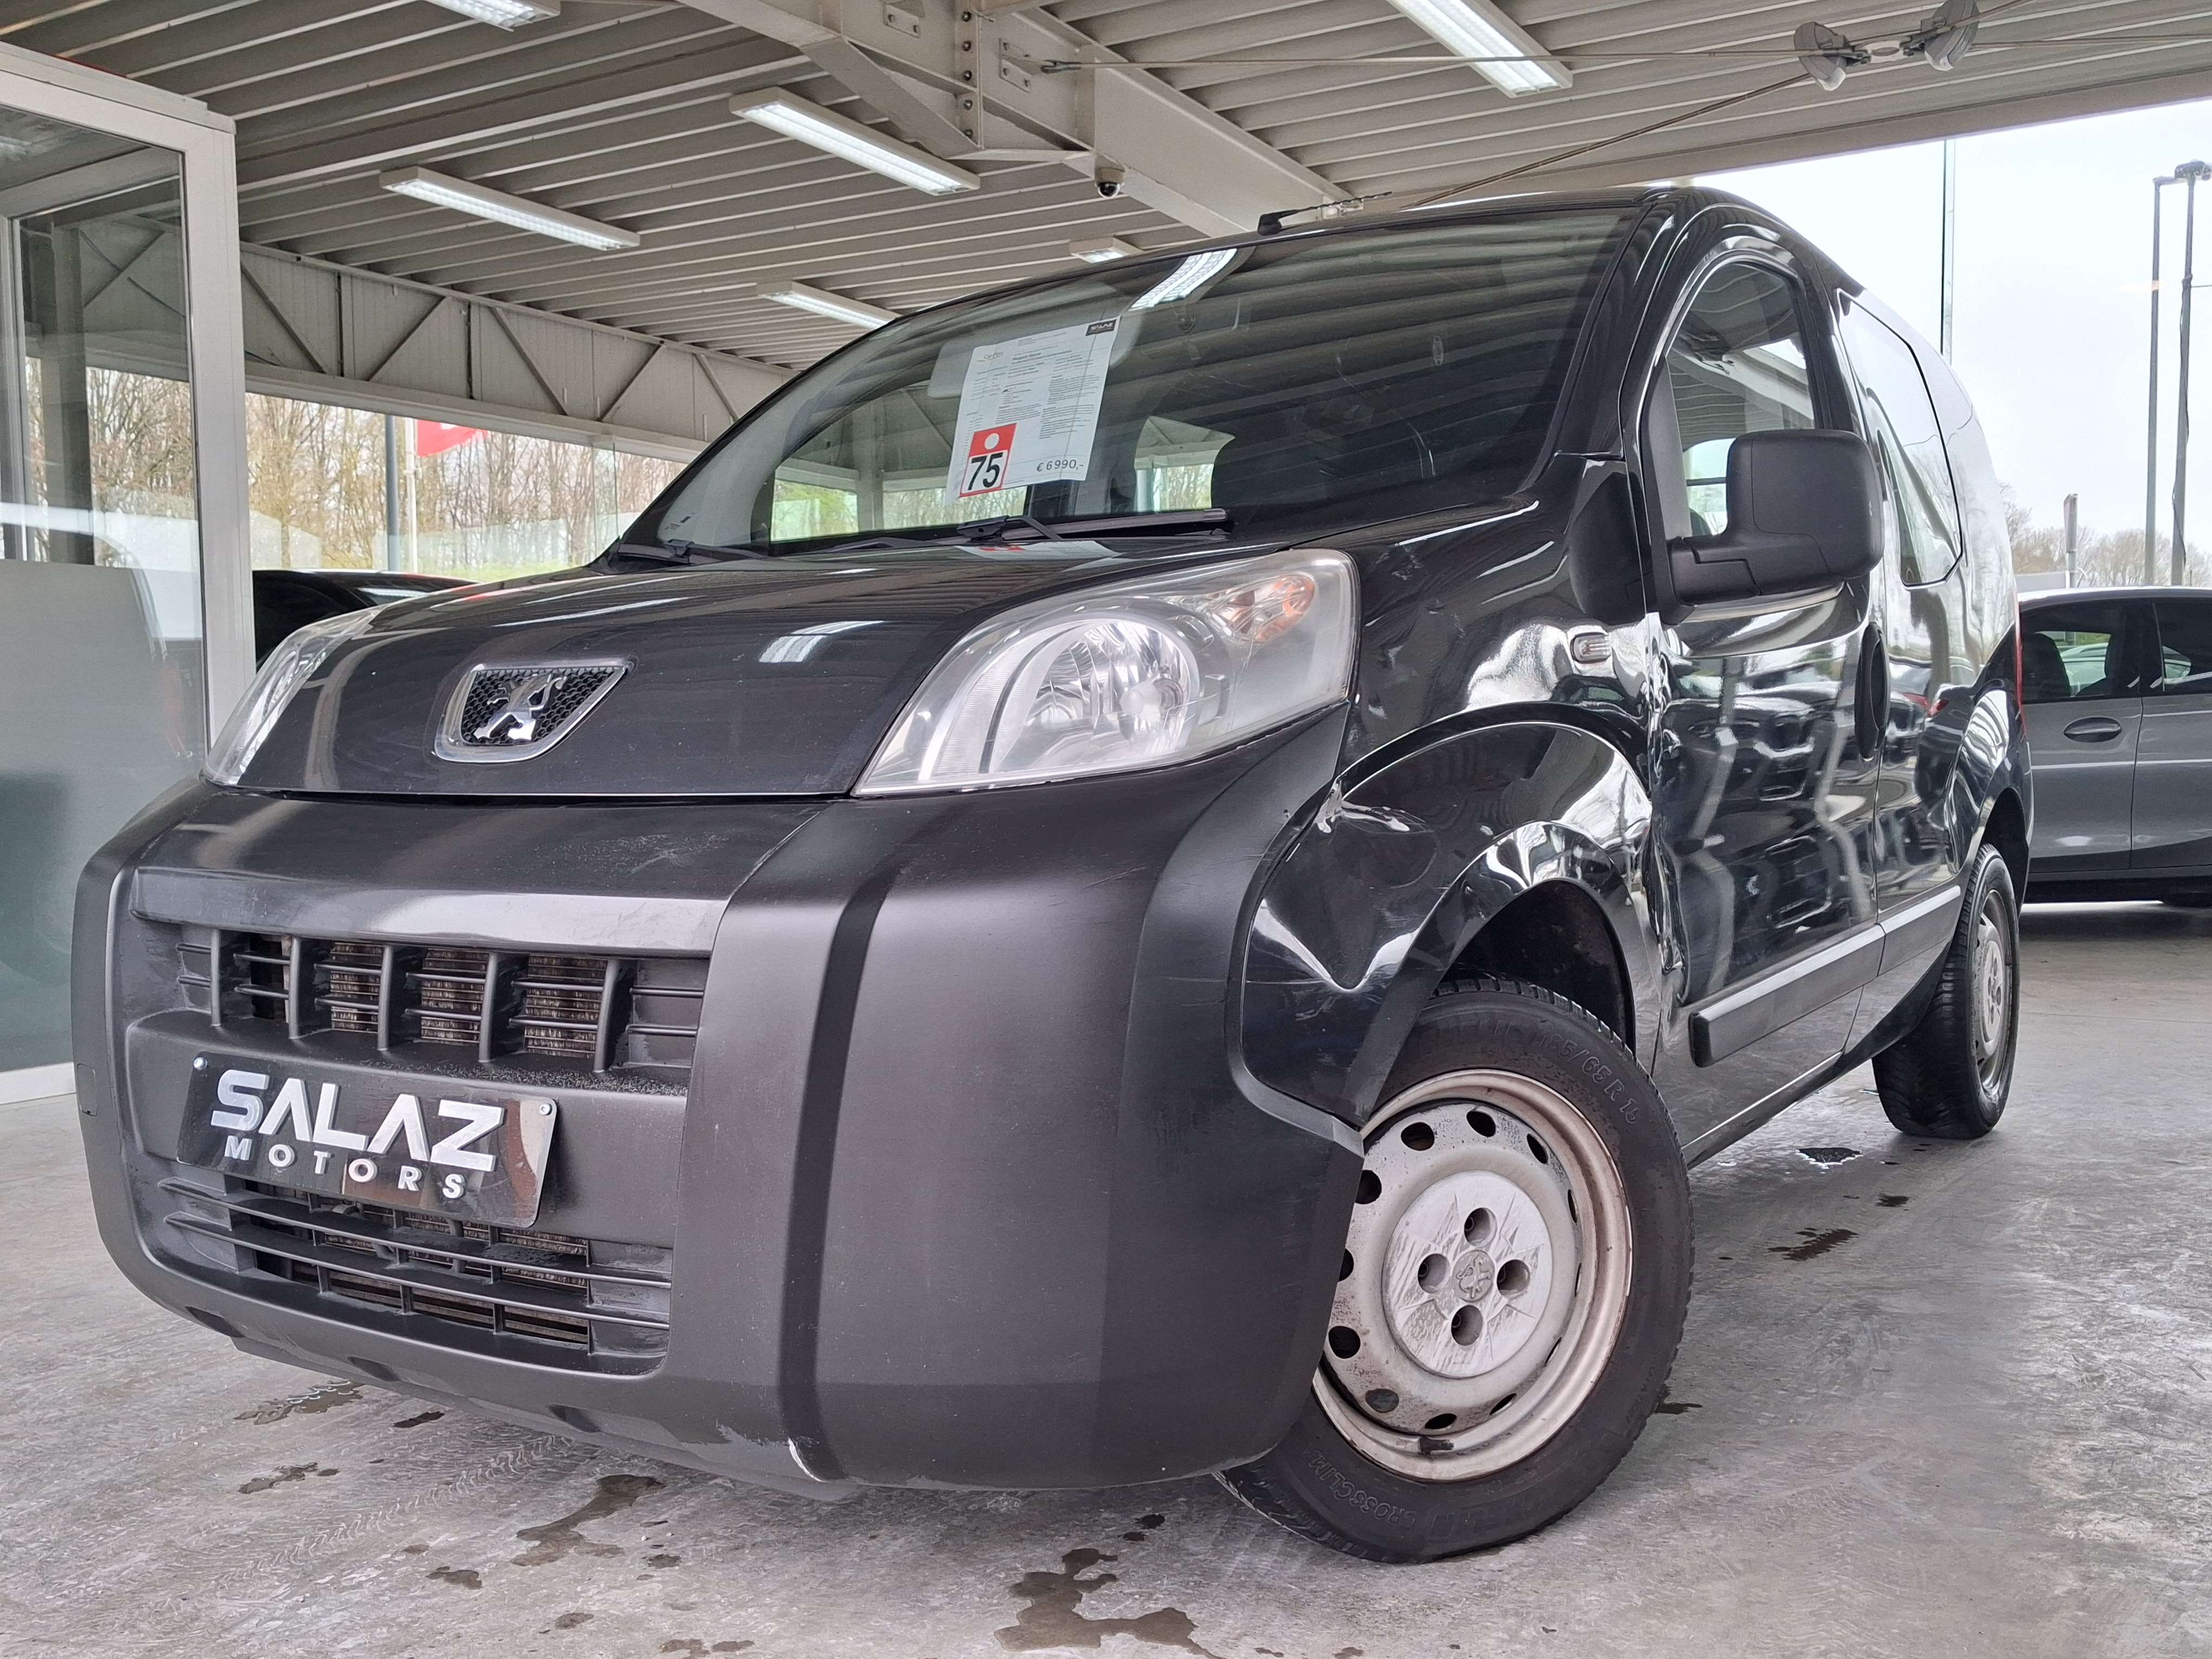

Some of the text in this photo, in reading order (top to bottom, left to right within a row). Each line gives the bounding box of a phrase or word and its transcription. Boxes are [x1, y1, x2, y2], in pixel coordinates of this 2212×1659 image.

[967, 452, 1004, 491] 75
[210, 1069, 505, 1172] SALAZ
[224, 1135, 465, 1199] MOTORS
